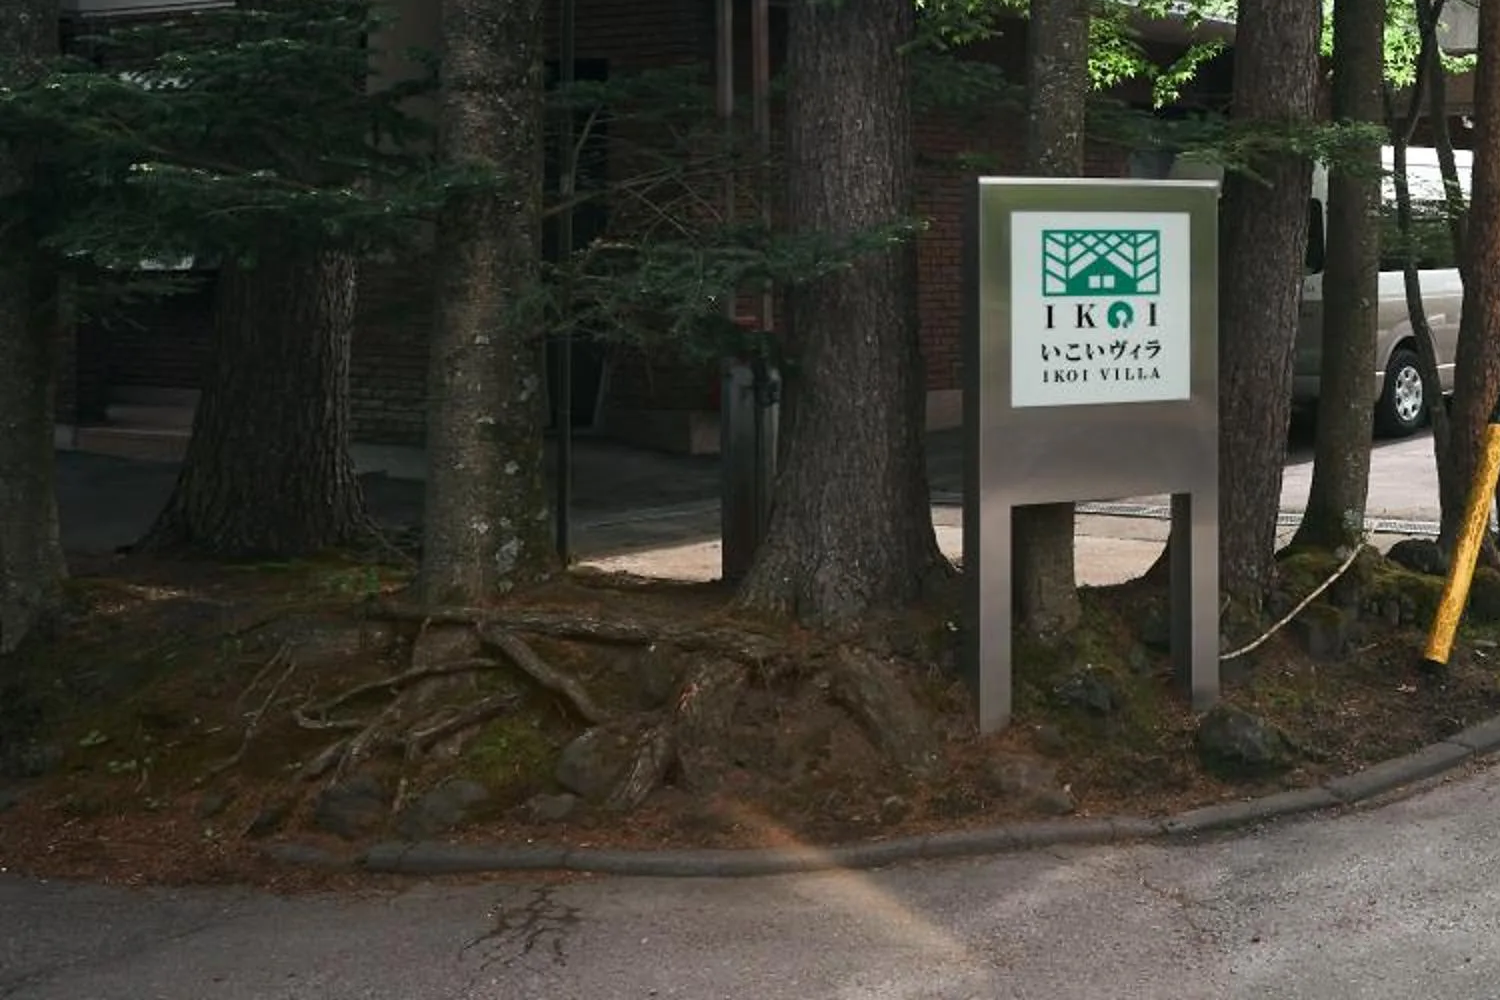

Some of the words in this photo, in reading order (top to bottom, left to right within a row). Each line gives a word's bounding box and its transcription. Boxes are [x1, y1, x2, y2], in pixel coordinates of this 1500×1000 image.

[1041, 339, 1162, 362] いこいヴィラ
[1043, 369, 1088, 383] IKOI
[1099, 367, 1161, 381] VILLA
